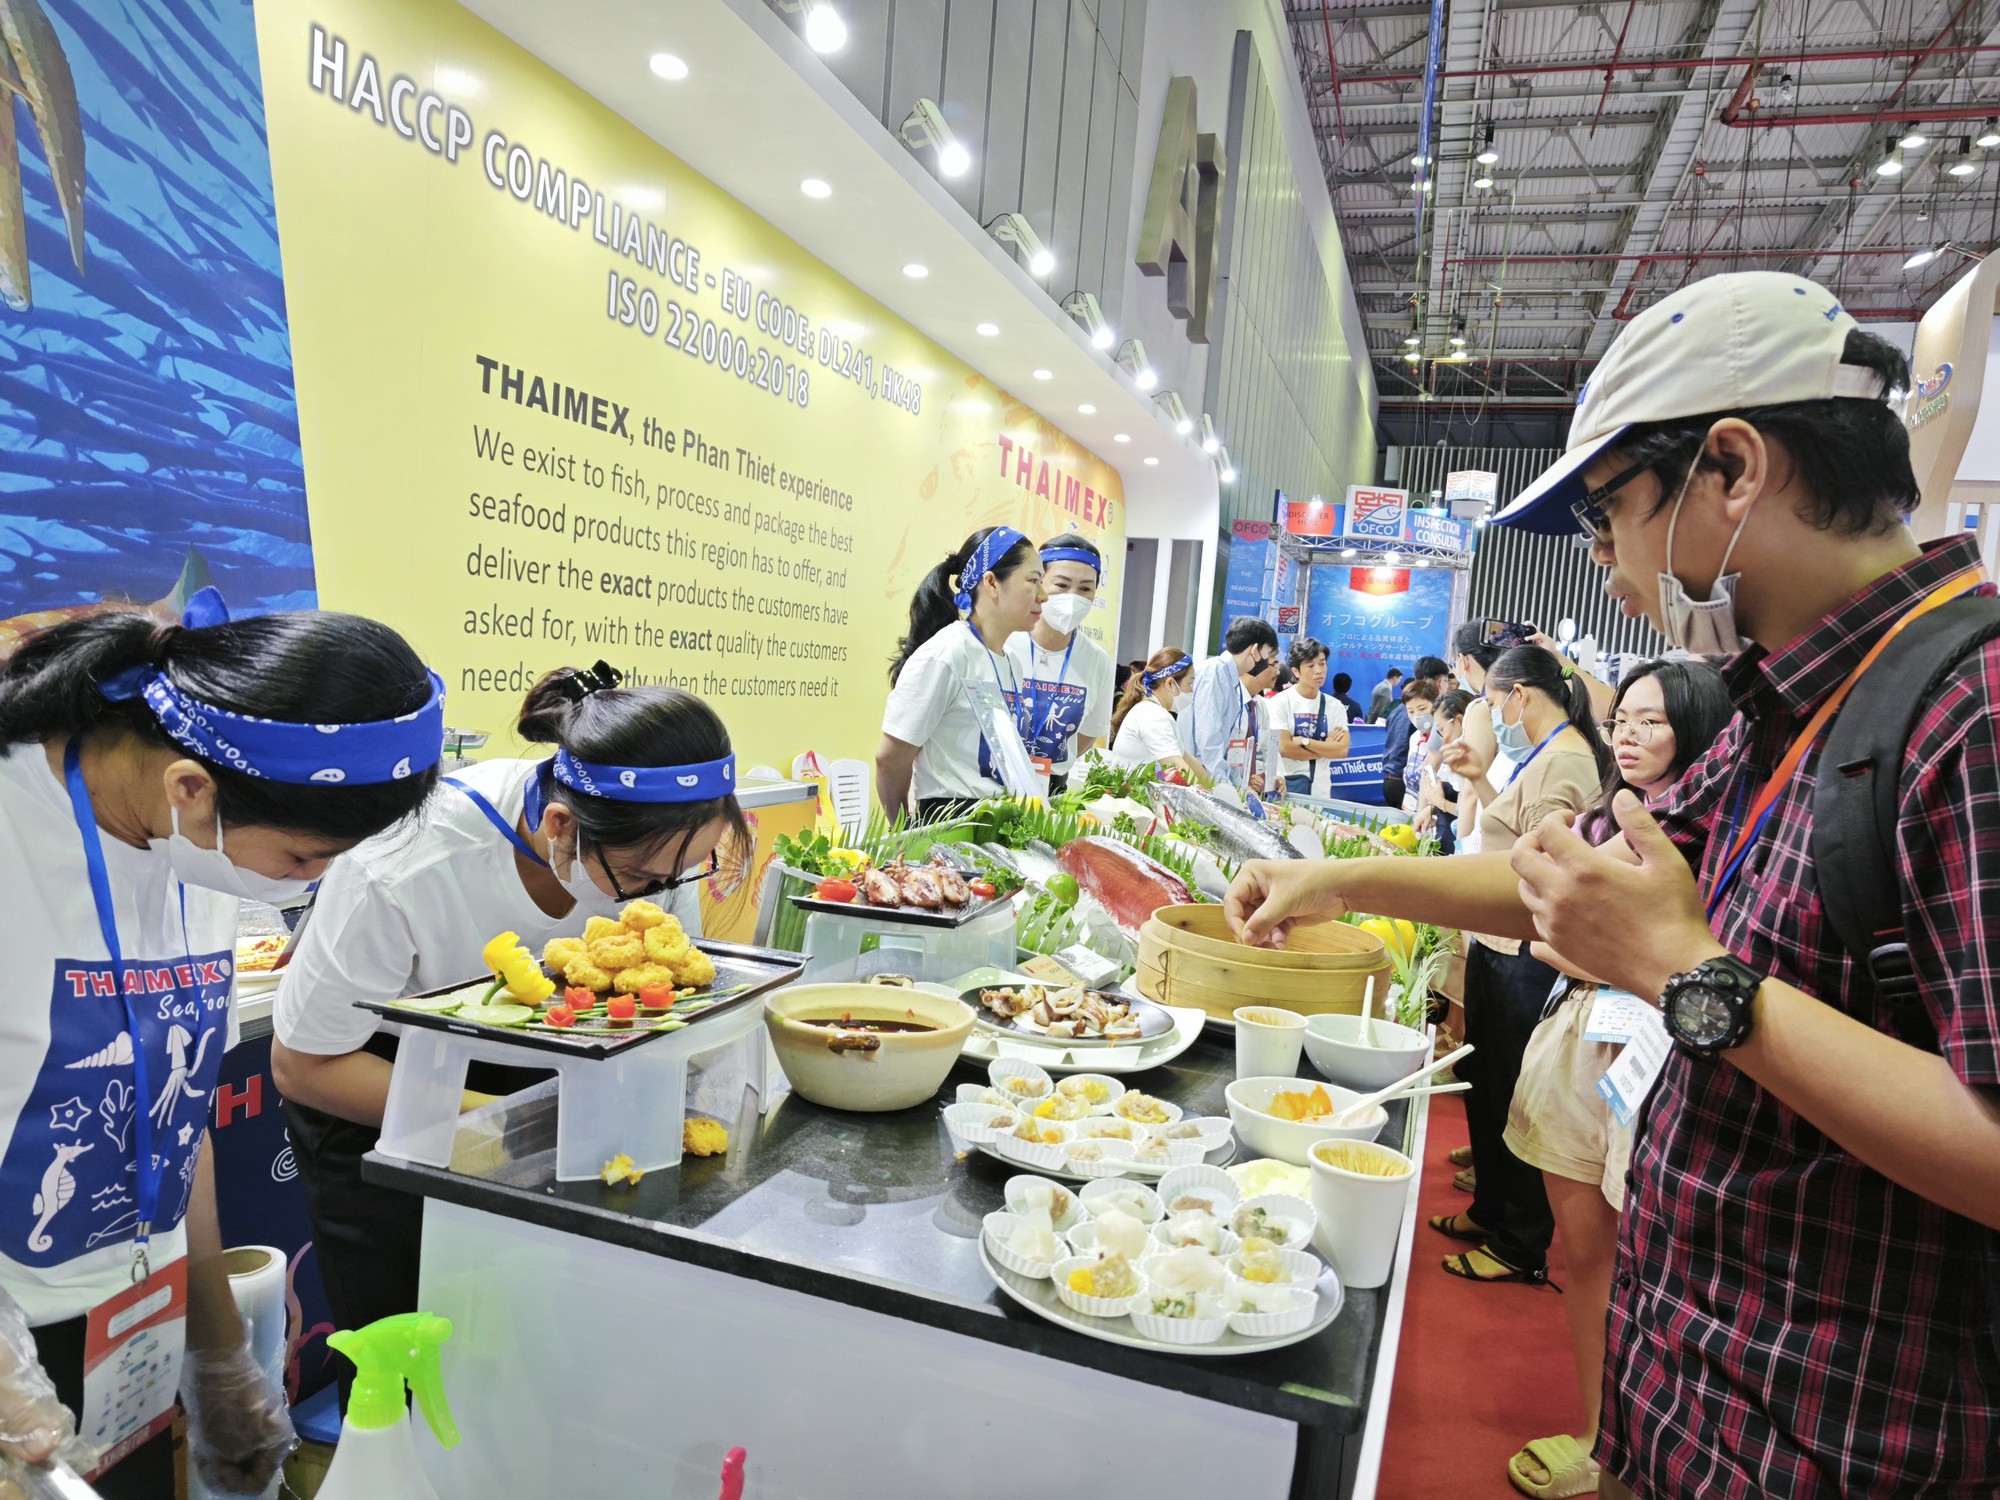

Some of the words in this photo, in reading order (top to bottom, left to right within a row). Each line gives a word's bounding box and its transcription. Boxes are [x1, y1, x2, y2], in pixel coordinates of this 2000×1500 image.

[309, 27, 473, 164] HACCP
[485, 133, 700, 291] COMPLIANCE
[721, 268, 751, 318] EU
[756, 293, 816, 358] CODE:
[819, 329, 880, 399] DL241,
[882, 366, 922, 415] HK48
[608, 273, 658, 334] ISO
[665, 303, 810, 407] 22000:2018
[476, 354, 634, 446] THAIMEX,
[643, 416, 675, 453] the
[683, 429, 729, 471] Phan
[736, 448, 775, 486] Thiet
[780, 471, 852, 511] experience
[473, 425, 514, 466] We
[523, 447, 576, 482] exist
[583, 459, 604, 488] to
[611, 463, 649, 505] fish,
[657, 484, 719, 518] process
[724, 502, 751, 526] and
[755, 512, 804, 544] package
[809, 522, 827, 546] the
[831, 527, 853, 553] best
[1234, 521, 1268, 535] OFCO
[1288, 511, 1329, 520] DISCVER
[1359, 523, 1394, 536] OFCO
[1414, 514, 1461, 536] INSPECTION
[469, 493, 565, 534] seafood
[574, 515, 660, 552] products
[667, 528, 696, 559] this
[702, 542, 747, 570] region
[752, 547, 773, 574] has
[778, 556, 789, 577] to
[793, 559, 822, 587] offer,
[826, 568, 846, 588] and
[1415, 528, 1462, 549] CONSULTING
[467, 543, 551, 585] deliver
[558, 558, 593, 591] the
[600, 572, 652, 599] exact
[658, 579, 727, 609] products
[732, 587, 754, 612] the
[758, 597, 820, 621] customers
[823, 601, 848, 625] have
[1231, 584, 1258, 593] SEAFOOD
[1227, 599, 1259, 608] SPECIALIST
[464, 603, 534, 638] asked
[542, 609, 576, 647] for,
[585, 616, 627, 645] with
[635, 619, 664, 647] the
[670, 629, 712, 651] exact
[717, 630, 763, 660] quality
[767, 633, 786, 657] the
[790, 640, 847, 661] customers
[1322, 611, 1434, 630] オフコグループ
[462, 661, 534, 692] needs
[704, 670, 726, 695] the
[731, 676, 796, 696] customers
[800, 676, 828, 696] need
[831, 677, 838, 697] it
[1022, 680, 1081, 696] HAIMEX
[65, 960, 226, 998] THAIMEX
